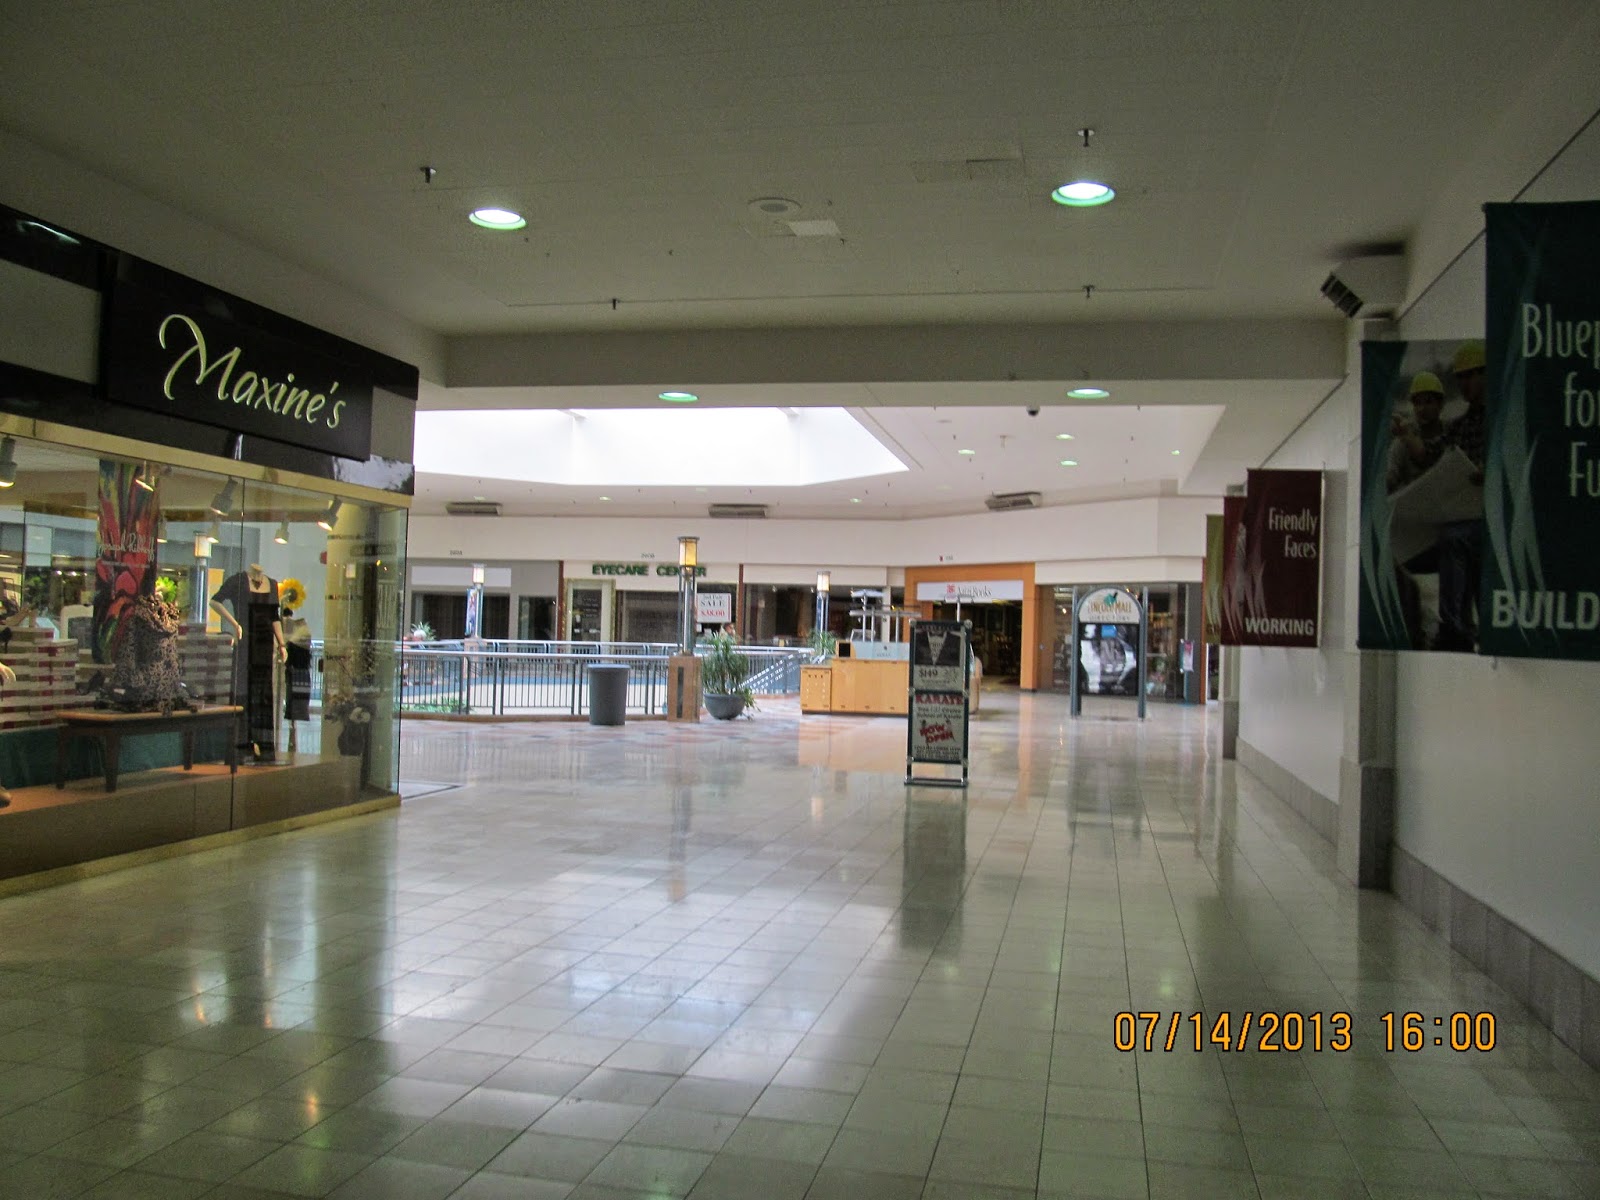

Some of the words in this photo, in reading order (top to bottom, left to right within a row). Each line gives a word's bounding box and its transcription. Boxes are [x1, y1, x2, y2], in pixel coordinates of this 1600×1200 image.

[158, 313, 346, 429] Maxine's
[1564, 371, 1600, 427] fo
[1268, 506, 1319, 536] Friendly
[1284, 534, 1317, 559] Faces
[592, 564, 650, 576] EYECARE
[656, 565, 707, 577] CENER
[1491, 590, 1600, 630] BUILD
[1244, 617, 1315, 637] WORKING
[915, 694, 964, 705] KARATE
